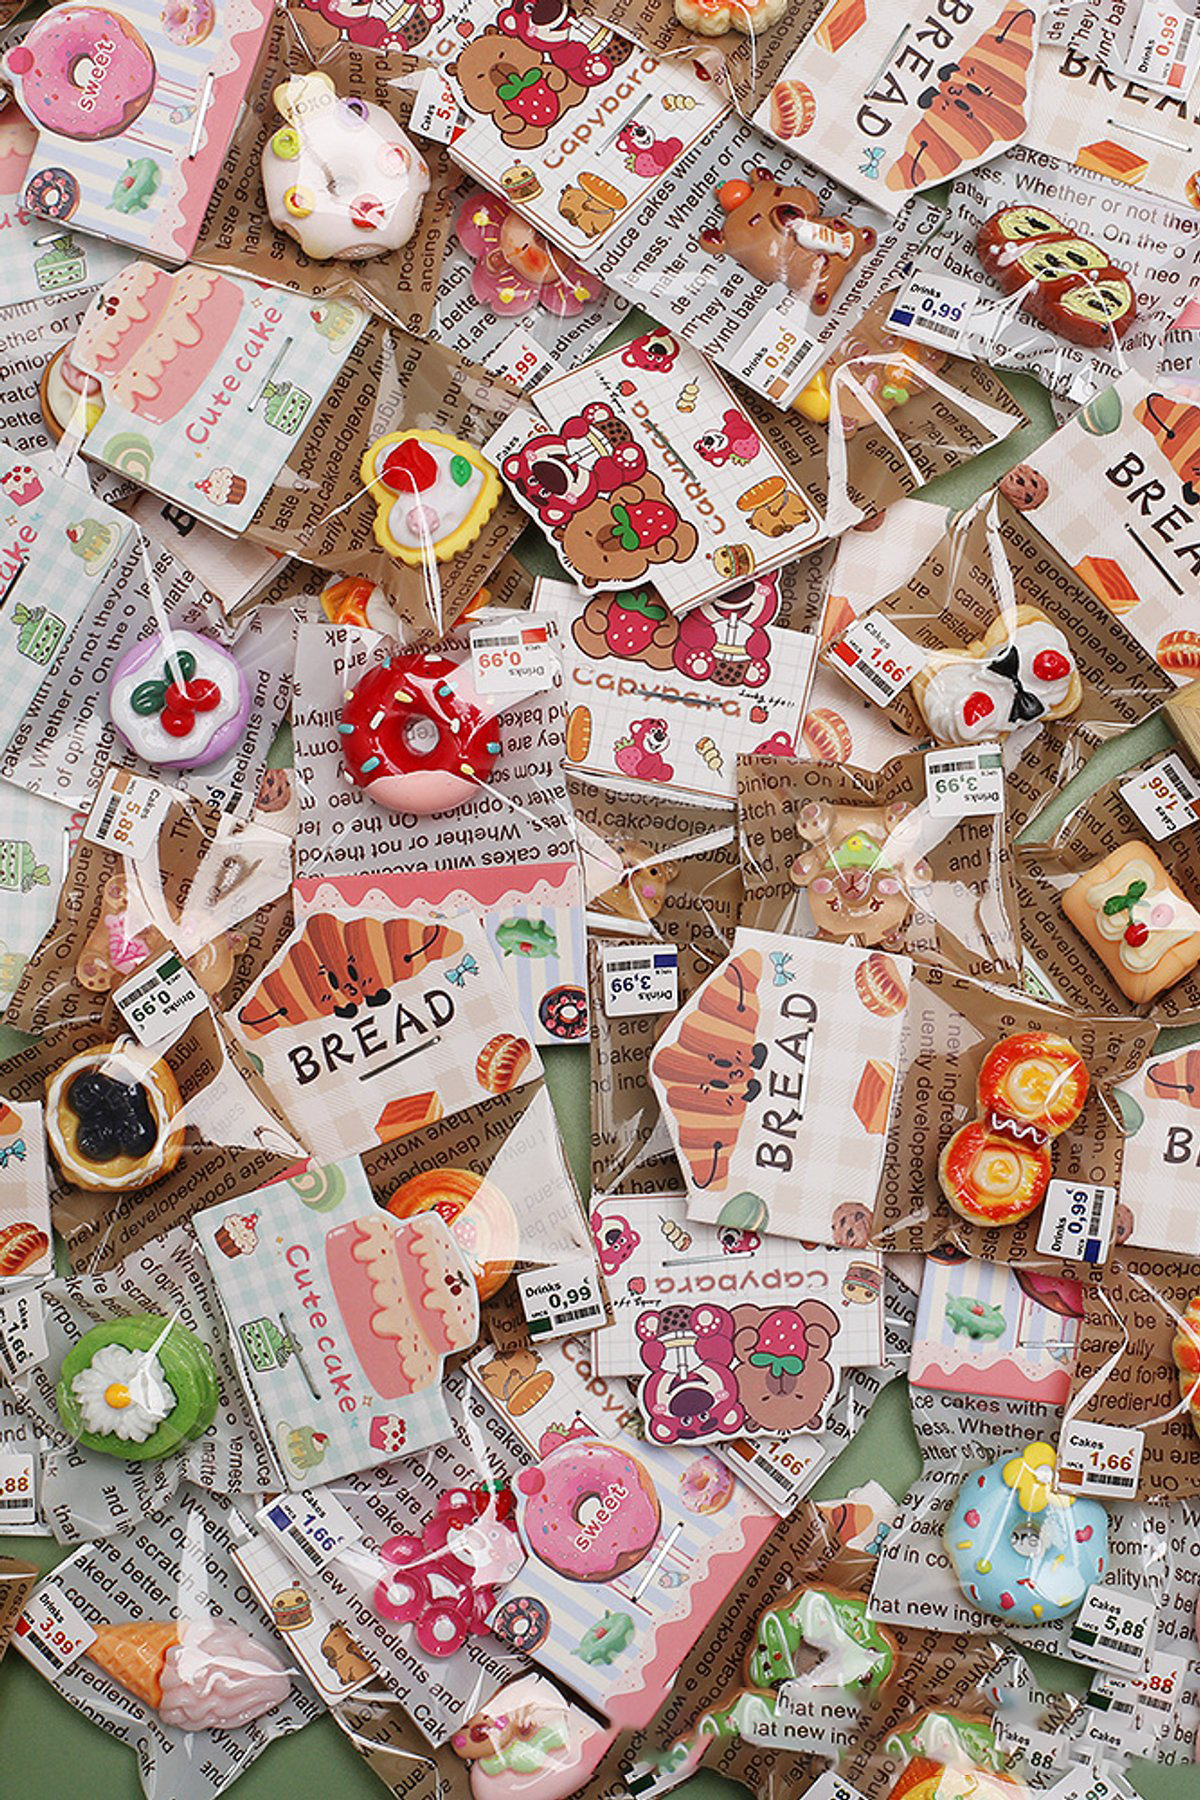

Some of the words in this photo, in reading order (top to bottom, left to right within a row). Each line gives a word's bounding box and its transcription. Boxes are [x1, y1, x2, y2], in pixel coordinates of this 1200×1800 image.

[1155, 15, 1179, 56] 0,99
[857, 0, 973, 136] BREAD
[1138, 39, 1155, 73] Drinks
[78, 39, 115, 111] sweet
[421, 104, 435, 131] Cakes
[543, 53, 661, 169] Capybara
[741, 151, 766, 175] On
[1004, 150, 1061, 170] cakes
[637, 183, 676, 226] cakes
[672, 149, 701, 179] with
[666, 162, 720, 230] Whether
[718, 145, 733, 166] or
[1016, 172, 1096, 207] Whether
[1102, 195, 1120, 216] or
[1132, 203, 1157, 224] not
[215, 206, 239, 250] taste
[1104, 223, 1130, 246] On
[1137, 231, 1167, 254] the
[721, 274, 743, 299] are
[838, 234, 898, 319] ingredients
[910, 284, 941, 298] Drinks
[921, 298, 961, 321] 0,99
[742, 347, 768, 378] Drinks
[764, 332, 797, 370] 0,99
[185, 377, 240, 443] Cute
[236, 306, 282, 372] cake
[504, 350, 537, 386] 3,99
[769, 427, 802, 466] taste
[272, 496, 299, 531] taste
[1105, 451, 1200, 577] BREA
[1001, 519, 1037, 559] taste
[864, 622, 891, 650] Cakes
[937, 609, 980, 644] tested
[480, 653, 521, 668] 0,99
[509, 667, 544, 677] Drinks
[871, 648, 906, 682] 1,66
[30, 689, 73, 770] Whether
[69, 668, 82, 686] or
[83, 636, 101, 663] not
[254, 670, 271, 706] and
[57, 768, 73, 787] of
[93, 656, 114, 684] On
[112, 623, 128, 652] the
[2, 723, 32, 778] cakes
[87, 721, 117, 789] scratch
[804, 772, 832, 786] On
[936, 776, 978, 793] 3,99
[1148, 776, 1179, 811] 1,66
[142, 789, 161, 818] Cakes
[964, 791, 999, 802] Drinks
[114, 800, 141, 843] 5,88
[352, 815, 384, 832] the
[389, 814, 418, 829] On
[1103, 792, 1138, 833] They
[1155, 806, 1177, 831] Cakes
[371, 840, 400, 857] not
[409, 835, 429, 849] or
[434, 824, 521, 848] Whether
[482, 845, 541, 865] cakes
[950, 856, 981, 871] and
[56, 933, 76, 959] On
[611, 975, 651, 993] 3,99
[639, 990, 672, 1000] Drinks
[132, 991, 171, 1023] 0,99
[163, 990, 196, 1016] Drinks
[288, 990, 454, 1085] BREAD
[618, 1020, 649, 1034] are
[945, 1025, 961, 1069] new
[756, 993, 818, 1172] BREAD
[1068, 1144, 1085, 1175] are
[631, 1177, 679, 1194] have
[1068, 1192, 1088, 1234] 0,99
[1051, 1217, 1066, 1252] Drinks
[141, 1257, 162, 1277] of
[654, 1268, 829, 1294] Capybara
[525, 1280, 562, 1298] Drinks
[549, 1285, 591, 1309] 0,99
[286, 1245, 327, 1330] Cute
[318, 1337, 357, 1413] cake
[1134, 1313, 1156, 1328] be
[1080, 1340, 1154, 1361] carefully
[941, 1397, 1000, 1412] cakes
[1007, 1402, 1048, 1418] with
[486, 1415, 531, 1466] cakes
[959, 1419, 1044, 1441] Whether
[1069, 1436, 1104, 1450] Cakes
[454, 1462, 473, 1483] of
[769, 1441, 803, 1476] 1,66
[1089, 1452, 1132, 1471] 1,66
[302, 1489, 327, 1519] Cakes
[398, 1488, 426, 1514] are
[53, 1504, 80, 1540] that
[299, 1513, 337, 1552] 1,66
[575, 1483, 628, 1551] sweet
[905, 1547, 920, 1563] in
[1172, 1539, 1186, 1552] of
[93, 1537, 122, 1562] are
[121, 1558, 171, 1606] better
[136, 1536, 194, 1592] scratch
[170, 1529, 228, 1588] opinion.
[234, 1586, 260, 1614] On
[39, 1593, 64, 1623] Drinks
[907, 1601, 948, 1617] new
[1090, 1597, 1122, 1614] Cakes
[40, 1618, 74, 1655] 3,99
[1104, 1616, 1145, 1639] 5,88
[346, 1594, 430, 1684] ingredients
[429, 1683, 465, 1715] and
[65, 1662, 145, 1720] gredients
[148, 1720, 174, 1754] and
[414, 1703, 448, 1741] Cak
[784, 1723, 825, 1740] new
